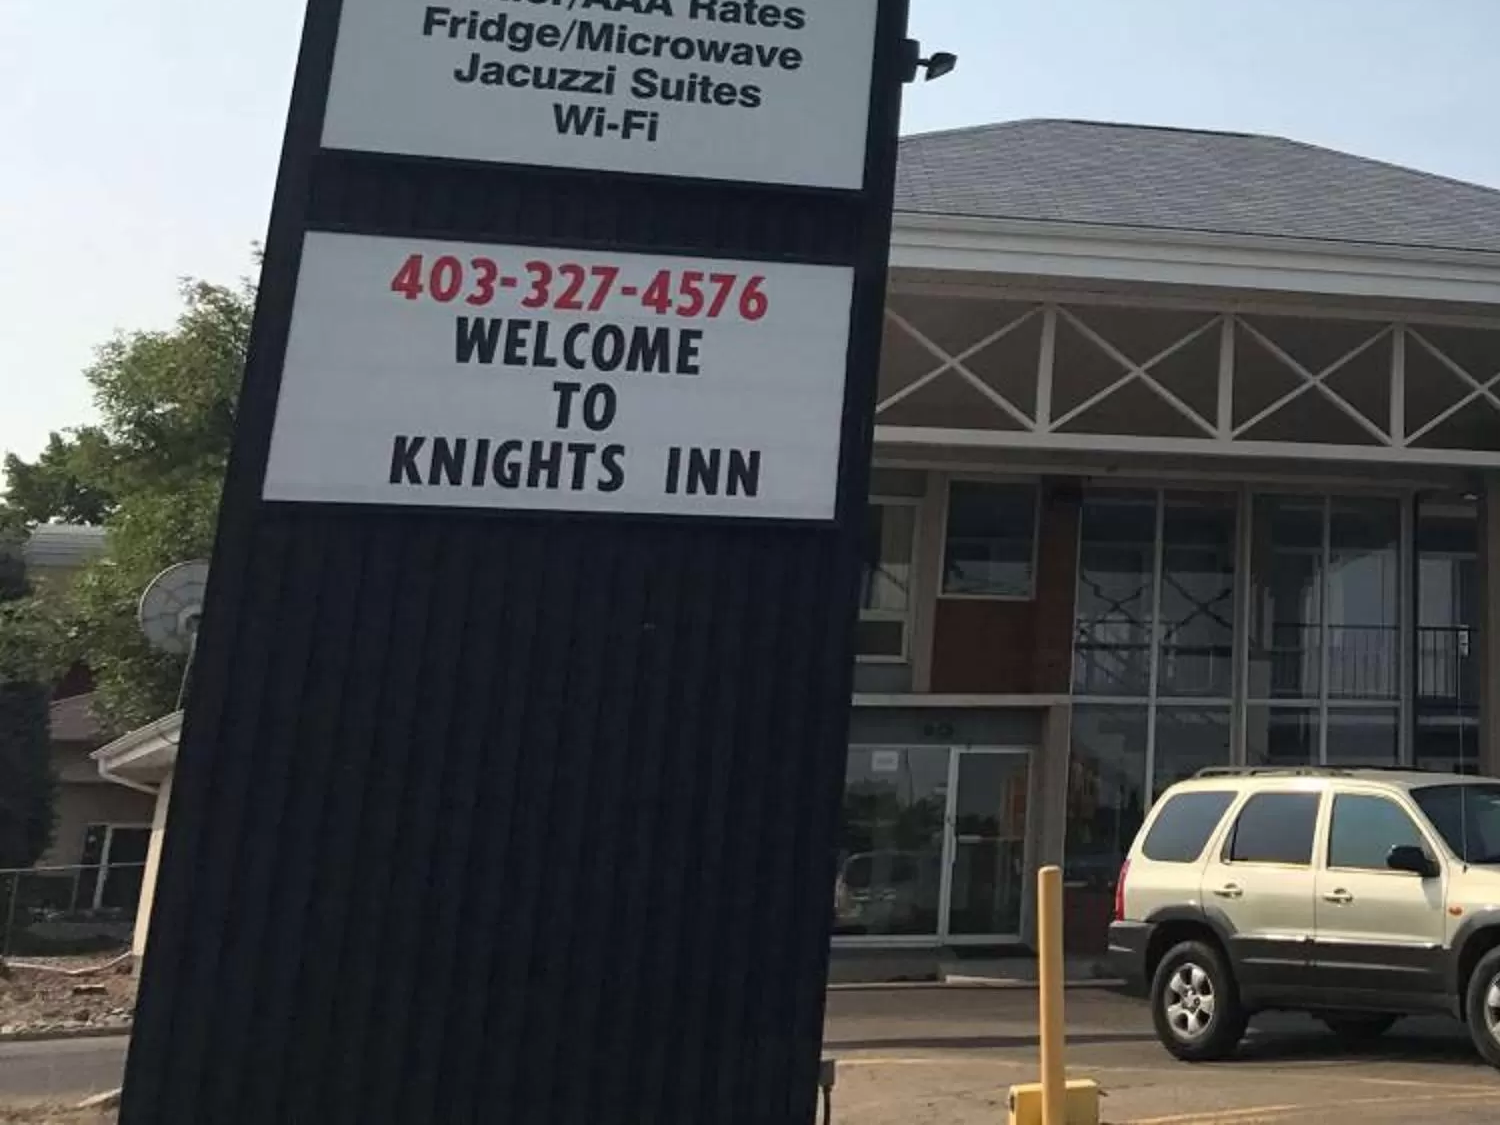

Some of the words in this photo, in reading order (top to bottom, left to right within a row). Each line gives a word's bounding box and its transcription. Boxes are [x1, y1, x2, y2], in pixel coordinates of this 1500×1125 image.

[423, 6, 803, 71] Fridge/Microwave
[453, 52, 617, 96] Jacuzzi
[630, 67, 762, 108] Suites
[552, 102, 660, 142] Wi-Fi
[390, 254, 769, 323] 403-327-4576
[455, 316, 704, 376] WELCOME
[552, 381, 617, 432] TO
[389, 435, 625, 493] KNIGHTS
[664, 446, 761, 498] INN
